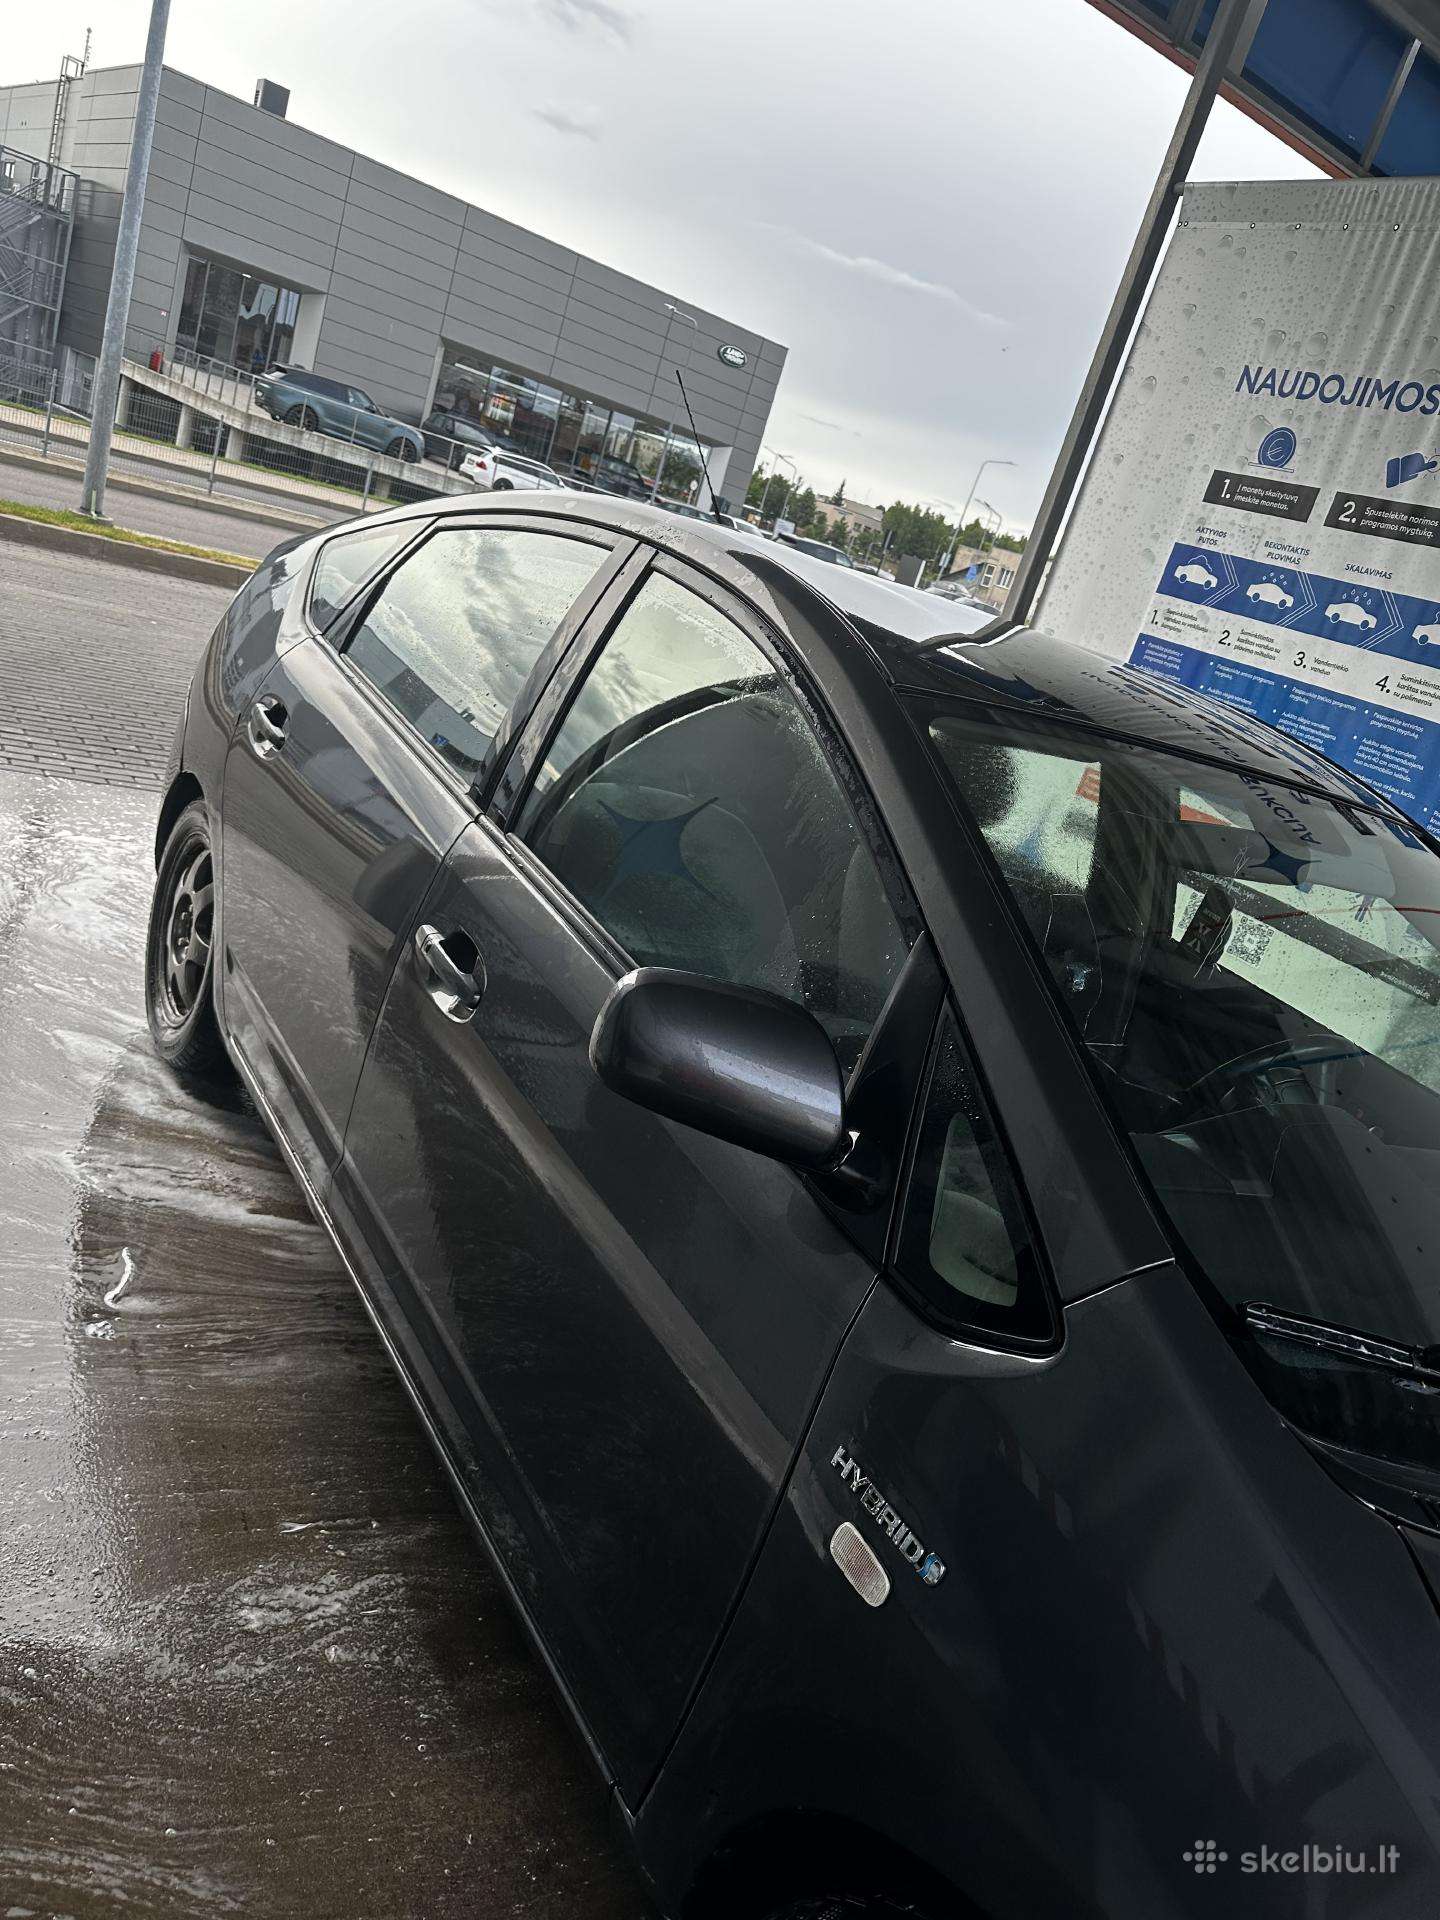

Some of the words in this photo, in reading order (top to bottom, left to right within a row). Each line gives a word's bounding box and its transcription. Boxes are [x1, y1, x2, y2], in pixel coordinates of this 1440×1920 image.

[1235, 364, 1440, 416] NAUDOJIMOS
[1221, 479, 1231, 499] 1.
[1338, 501, 1357, 524] 2.
[1359, 518, 1399, 530] programos
[1408, 516, 1440, 527] norimos
[1196, 526, 1228, 539] AKTYVIOS
[1198, 536, 1218, 546] PUTOS
[1264, 540, 1310, 557] BEKONTAKTIS
[1266, 552, 1301, 565] PLOVIMAS
[1344, 563, 1393, 581] SKALAVIMAS
[1151, 609, 1159, 625] 1.
[1218, 629, 1231, 647] 2.
[1293, 651, 1307, 669] 3.
[1310, 666, 1331, 676] vanduo
[1375, 675, 1390, 694] 4.
[1393, 691, 1401, 699] su
[1400, 693, 1433, 707] polimerais
[830, 1445, 925, 1563] HYBRID
